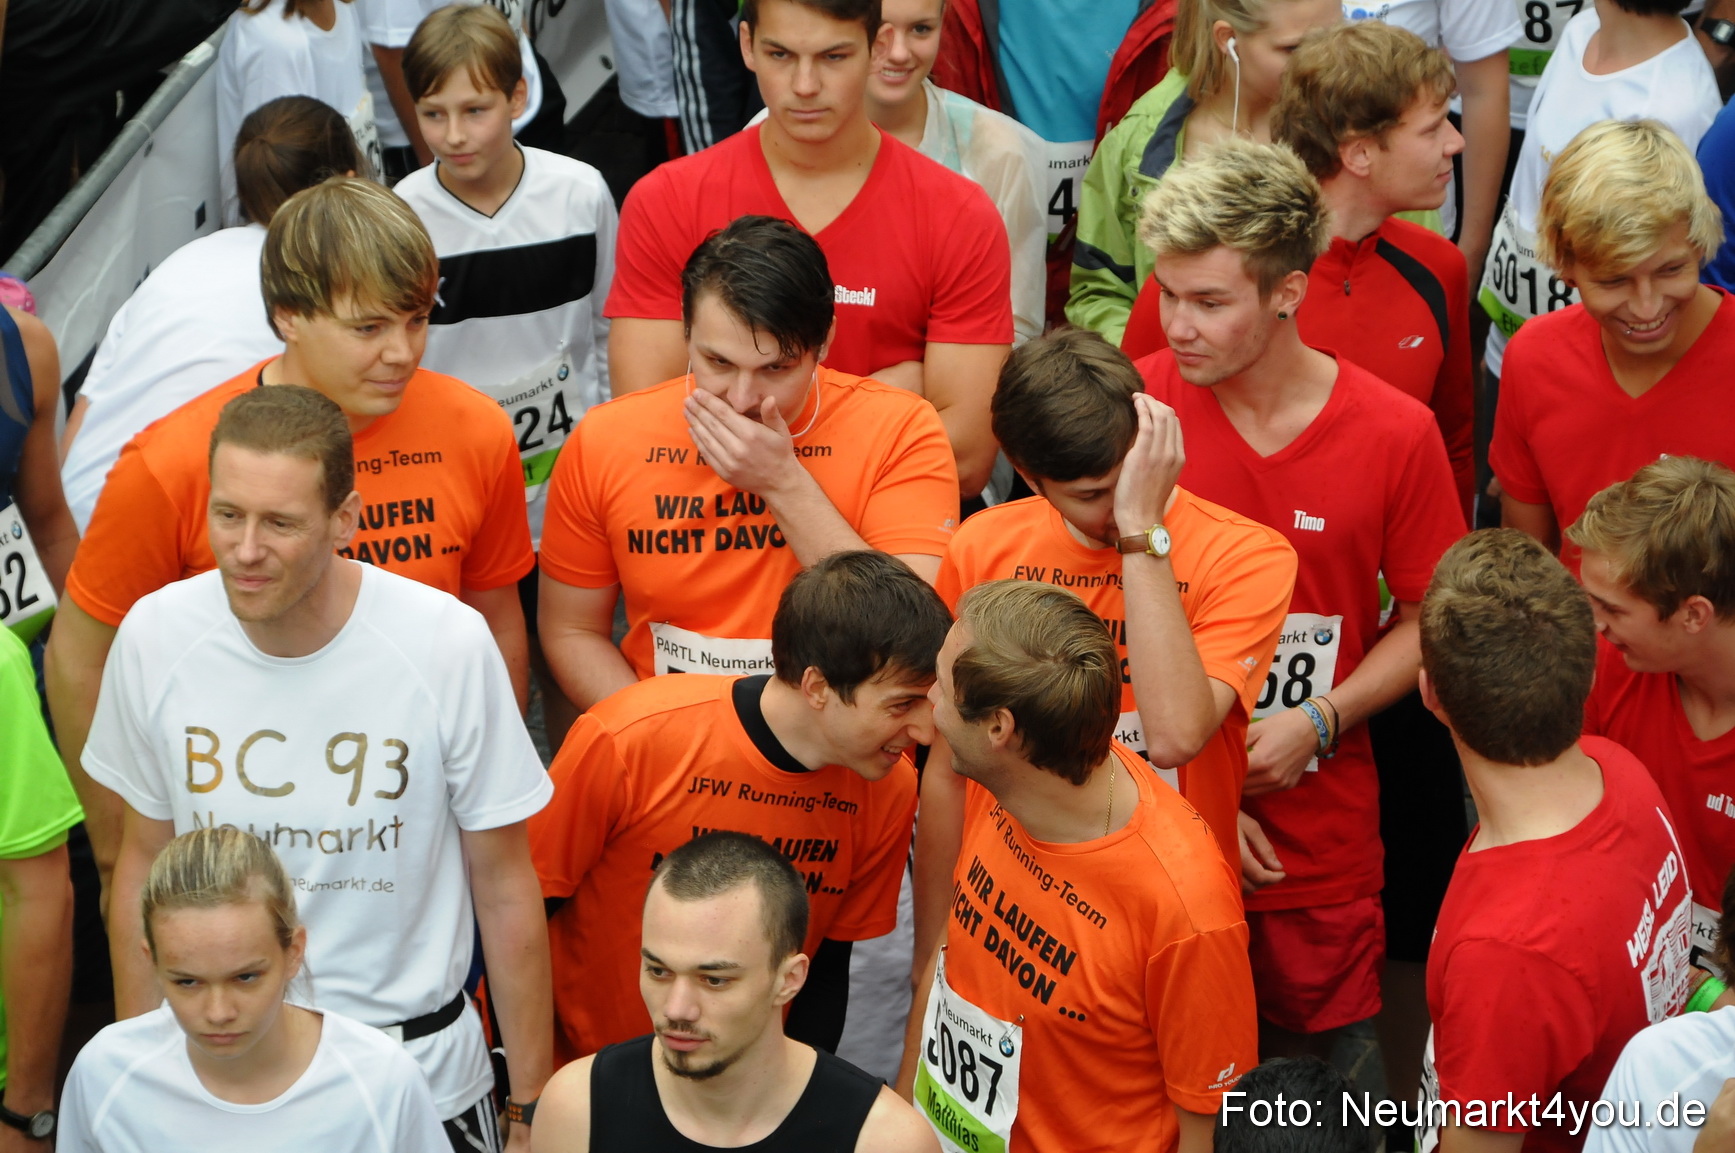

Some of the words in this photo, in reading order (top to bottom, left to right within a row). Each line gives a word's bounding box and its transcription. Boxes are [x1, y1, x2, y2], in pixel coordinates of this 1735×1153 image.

[1048, 177, 1077, 225] 4
[834, 285, 876, 307] Steckl
[499, 377, 554, 408] eumarkt
[513, 390, 573, 453] 24
[356, 450, 442, 475] ng-Team
[645, 447, 689, 464] JFW
[655, 494, 704, 520] WIR
[715, 492, 771, 517] LAU
[1293, 509, 1326, 532] Timo
[627, 528, 704, 554] NICHT
[715, 524, 787, 551] DAVO
[1013, 565, 1047, 583] FW
[656, 636, 696, 663] PARTL
[700, 650, 774, 670] Neumark
[1278, 630, 1307, 645] arkt
[185, 726, 295, 798] BC
[325, 731, 409, 807] 93
[688, 777, 732, 797] JFW
[737, 783, 858, 816] Running-Team
[1003, 824, 1108, 930] Running-Team
[967, 854, 995, 906] WIR
[993, 889, 1078, 977] LAUFEN
[984, 924, 1058, 1006] DAVON
[927, 1085, 980, 1153] Matthias
